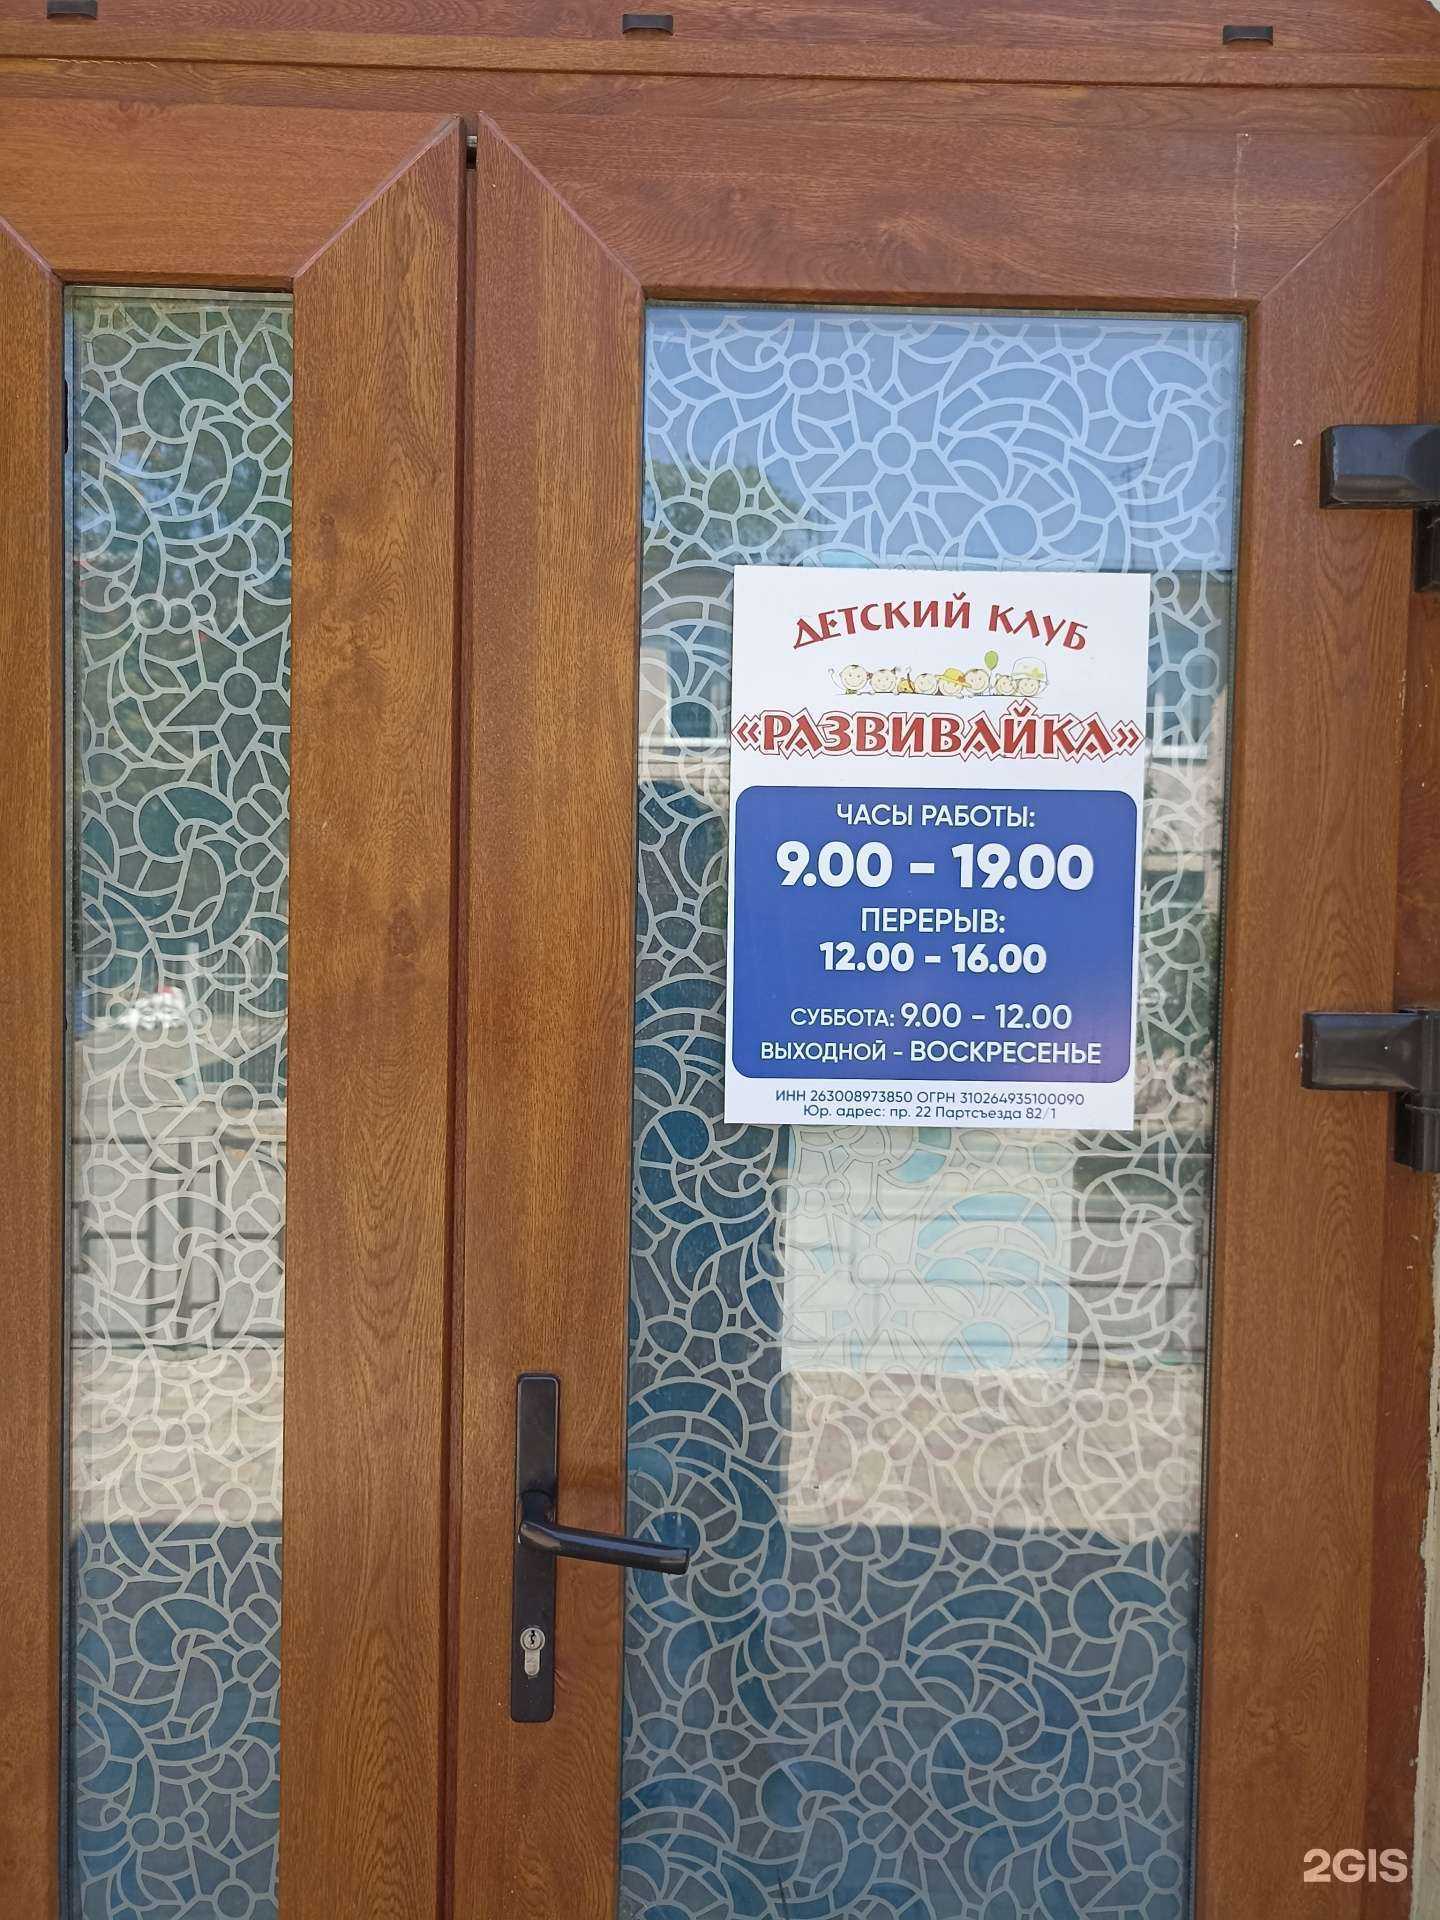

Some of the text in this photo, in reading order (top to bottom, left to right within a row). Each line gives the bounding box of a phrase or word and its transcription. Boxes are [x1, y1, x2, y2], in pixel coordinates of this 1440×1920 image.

[793, 591, 1088, 651] ДЕТСКИЙ КЛУБ
[732, 699, 1144, 762] «РАЗВИВАЙКА»
[837, 804, 1035, 827] ЧАСЫ РАБОТЫ:
[776, 840, 893, 888] 9.00
[951, 842, 1094, 891] 19.00
[861, 907, 1006, 933] ПЕРЕРЫВ:
[819, 942, 914, 972] 12.00
[951, 943, 1047, 974] 16.00
[790, 1008, 895, 1028] СУББОТА:
[901, 1002, 962, 1028] 9.00
[995, 1004, 1072, 1030] 12.00
[760, 1040, 886, 1062] ВЫХОДНОЙ
[910, 1040, 1102, 1064] ВОСКРЕСЕНЬЕ
[775, 1090, 1085, 1106] ИНН 263008973850 ОГРН 310264935100090
[803, 1105, 1056, 1120] Юр. адрес: пр. 22 Партсъезда 82/1
